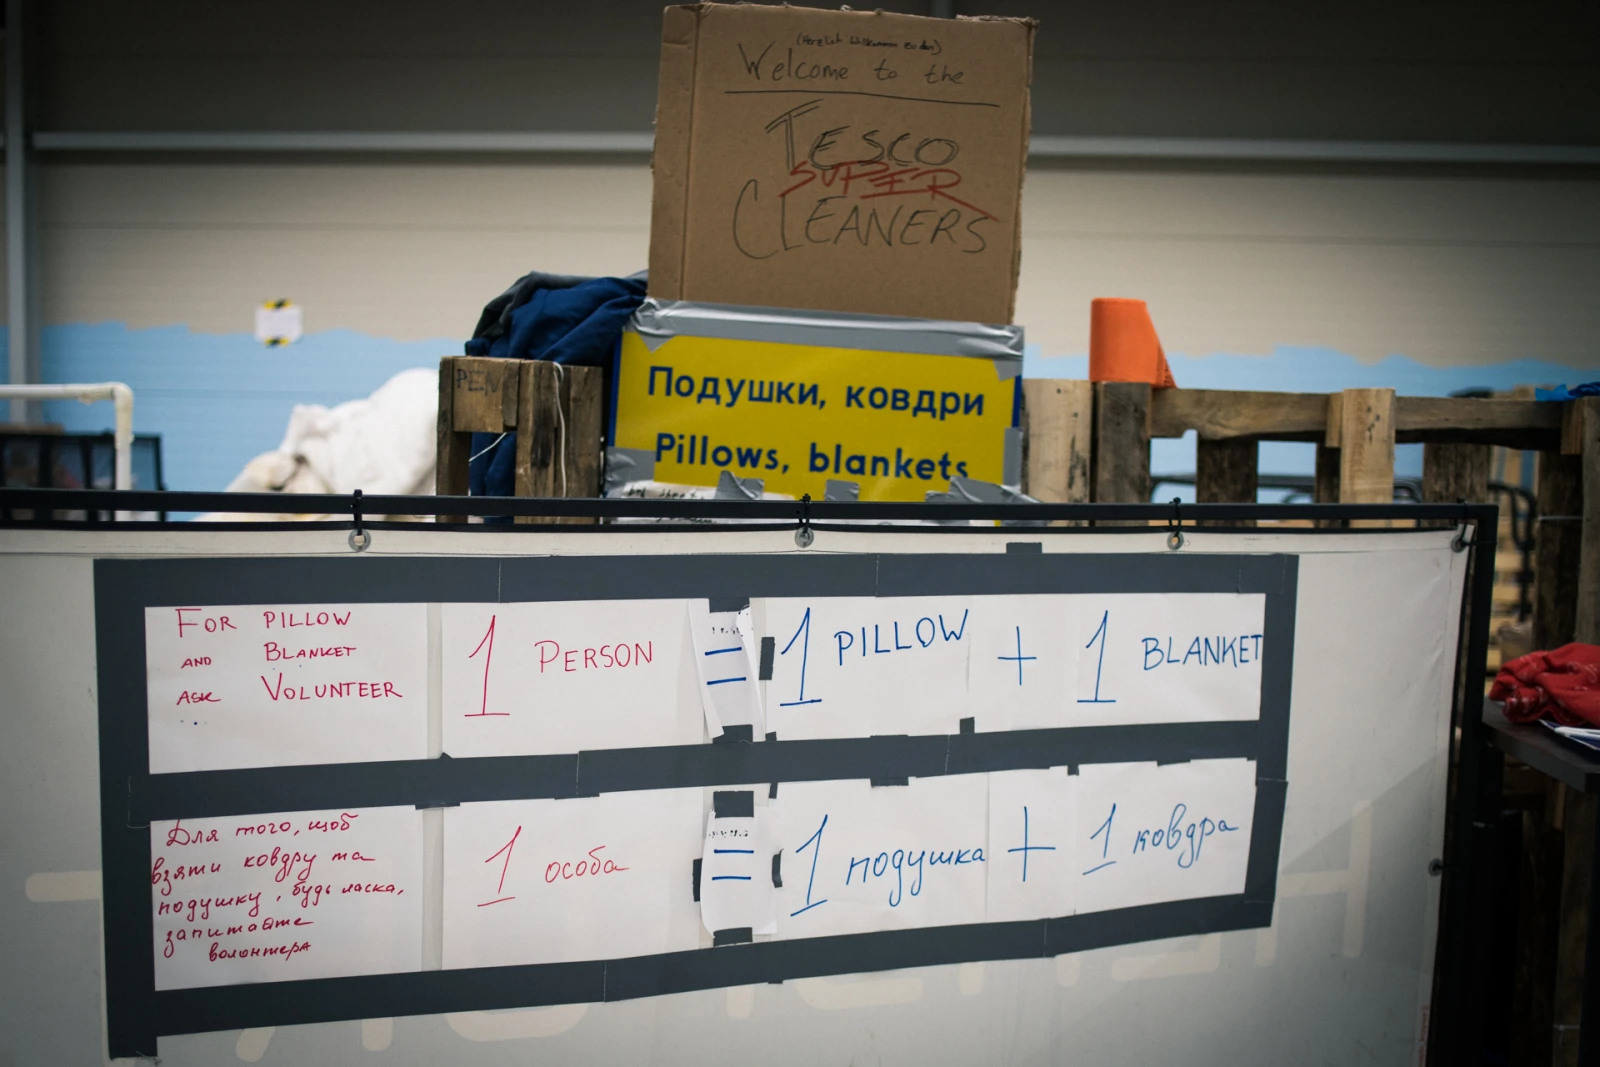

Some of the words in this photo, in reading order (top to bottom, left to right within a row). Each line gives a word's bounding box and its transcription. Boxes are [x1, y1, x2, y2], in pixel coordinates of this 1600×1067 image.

[738, 41, 849, 81] Welcome
[874, 59, 897, 81] to
[924, 64, 965, 85] the
[764, 98, 960, 171] TESCO
[778, 160, 999, 223] SUPER
[648, 365, 826, 410] Подушки,
[845, 384, 984, 421] ковдри
[655, 433, 790, 475] Pillows,
[809, 442, 969, 481] blankets
[175, 608, 237, 638] FOR
[263, 611, 351, 629] PILLOW
[180, 656, 212, 669] AND
[263, 641, 357, 661] BLANKET
[464, 614, 510, 717] 1
[534, 640, 652, 673] PERSON
[780, 607, 823, 707] 1
[834, 608, 969, 666] PILLOW
[1077, 610, 1116, 702] 1
[1141, 634, 1264, 671] BLANKET
[176, 690, 222, 706] ASK
[261, 672, 403, 701] VOLUNTEER
[166, 819, 219, 847] Для
[308, 812, 358, 832] щоб
[151, 857, 221, 897] взяти
[244, 846, 317, 883] ковдру
[332, 850, 376, 862] та
[477, 826, 522, 907] 1
[544, 846, 630, 883] особа
[790, 814, 828, 917] 1
[846, 845, 986, 907] подушка
[1083, 803, 1117, 875] 1
[1133, 804, 1239, 869] ковдра
[292, 880, 331, 908] будь
